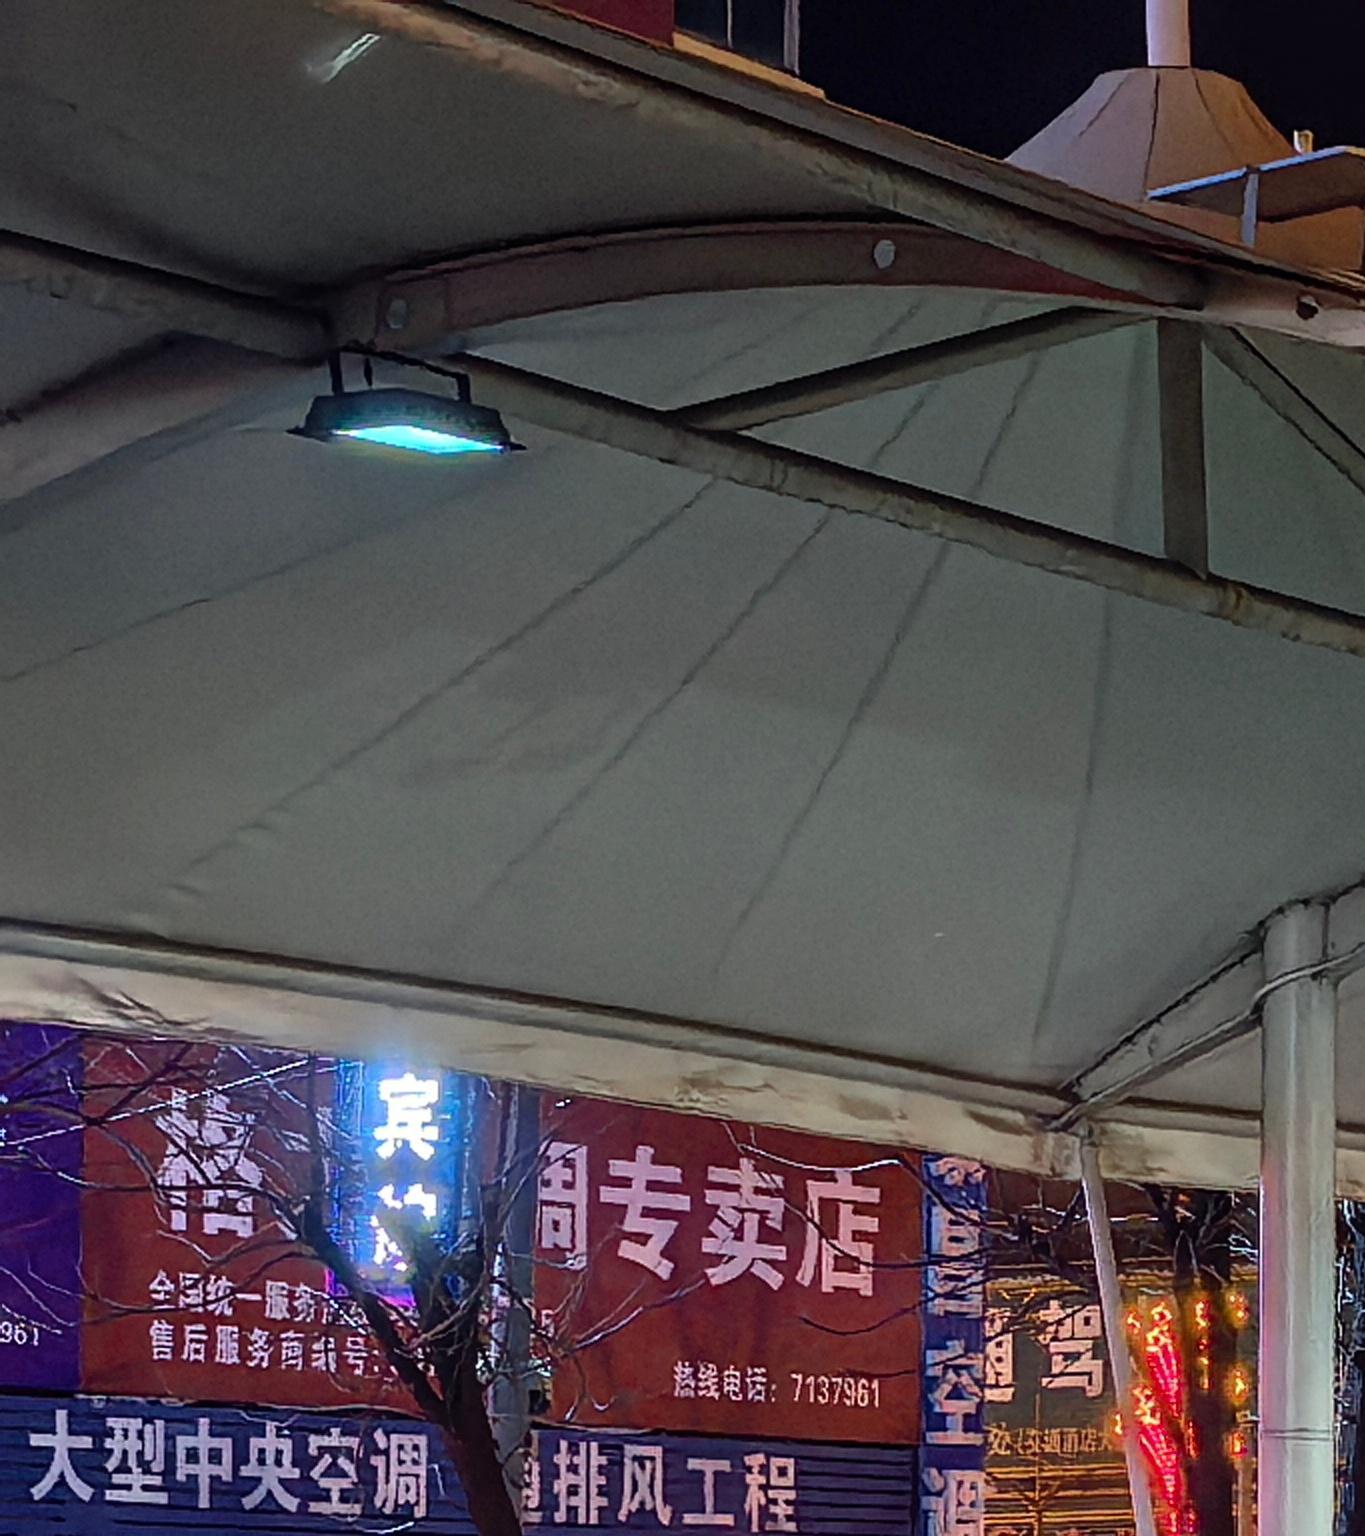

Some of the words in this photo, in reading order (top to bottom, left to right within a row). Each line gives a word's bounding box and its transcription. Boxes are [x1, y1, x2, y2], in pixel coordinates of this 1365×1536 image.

[790, 1373, 879, 1408] 7137961
[29, 1409, 428, 1519] 大型中央空调
